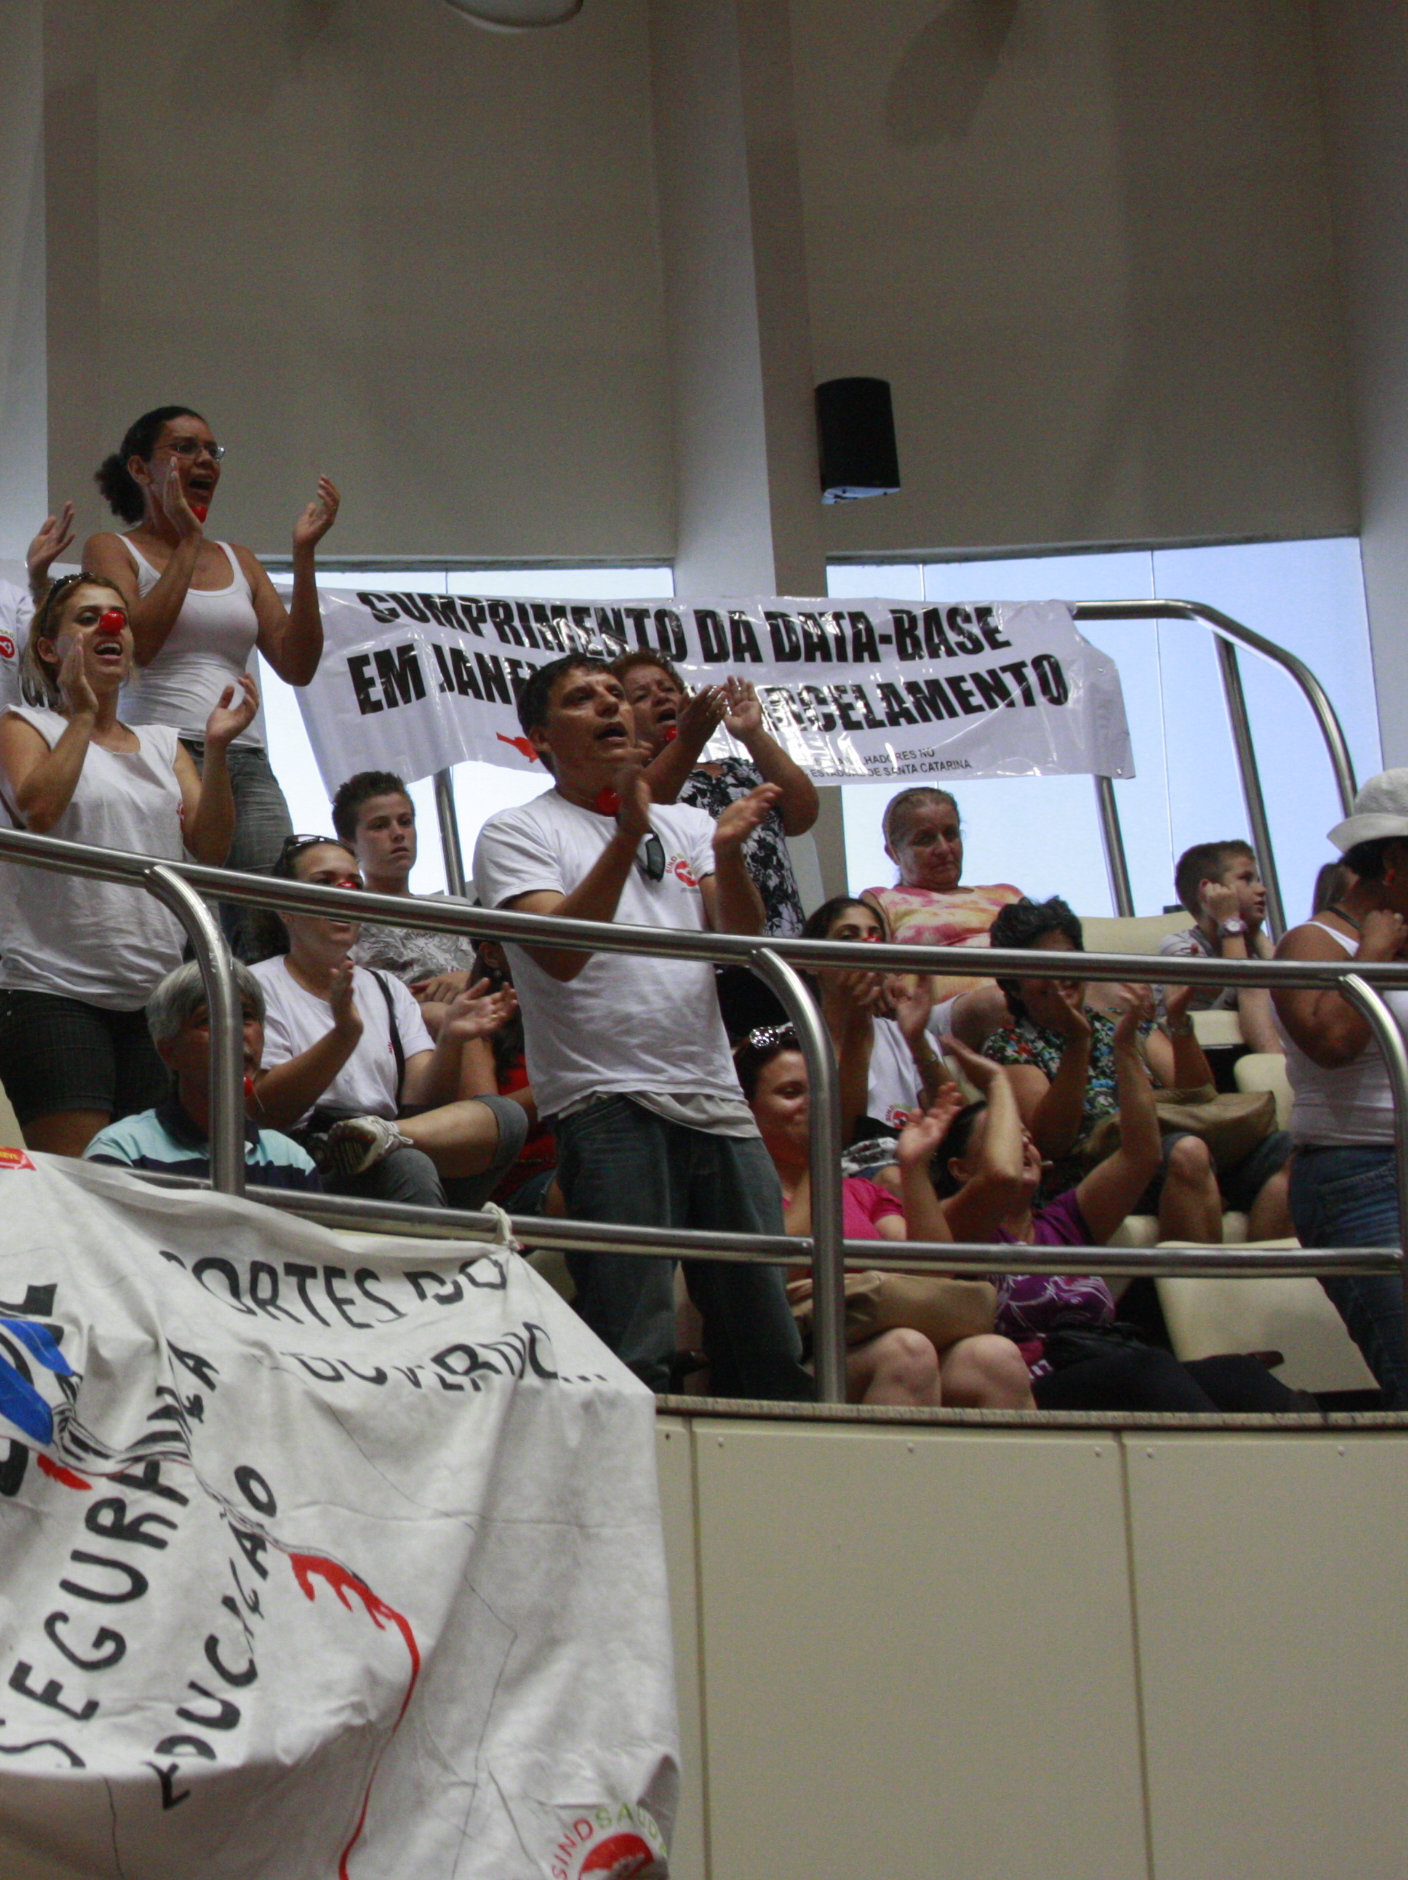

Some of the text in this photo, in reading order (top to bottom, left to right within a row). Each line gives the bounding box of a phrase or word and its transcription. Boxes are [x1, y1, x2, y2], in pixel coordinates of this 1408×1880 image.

[356, 591, 1012, 664] CUMPRIMENTO DA DATA-BASE
[346, 642, 427, 715] EM
[920, 760, 973, 774] CATARINA
